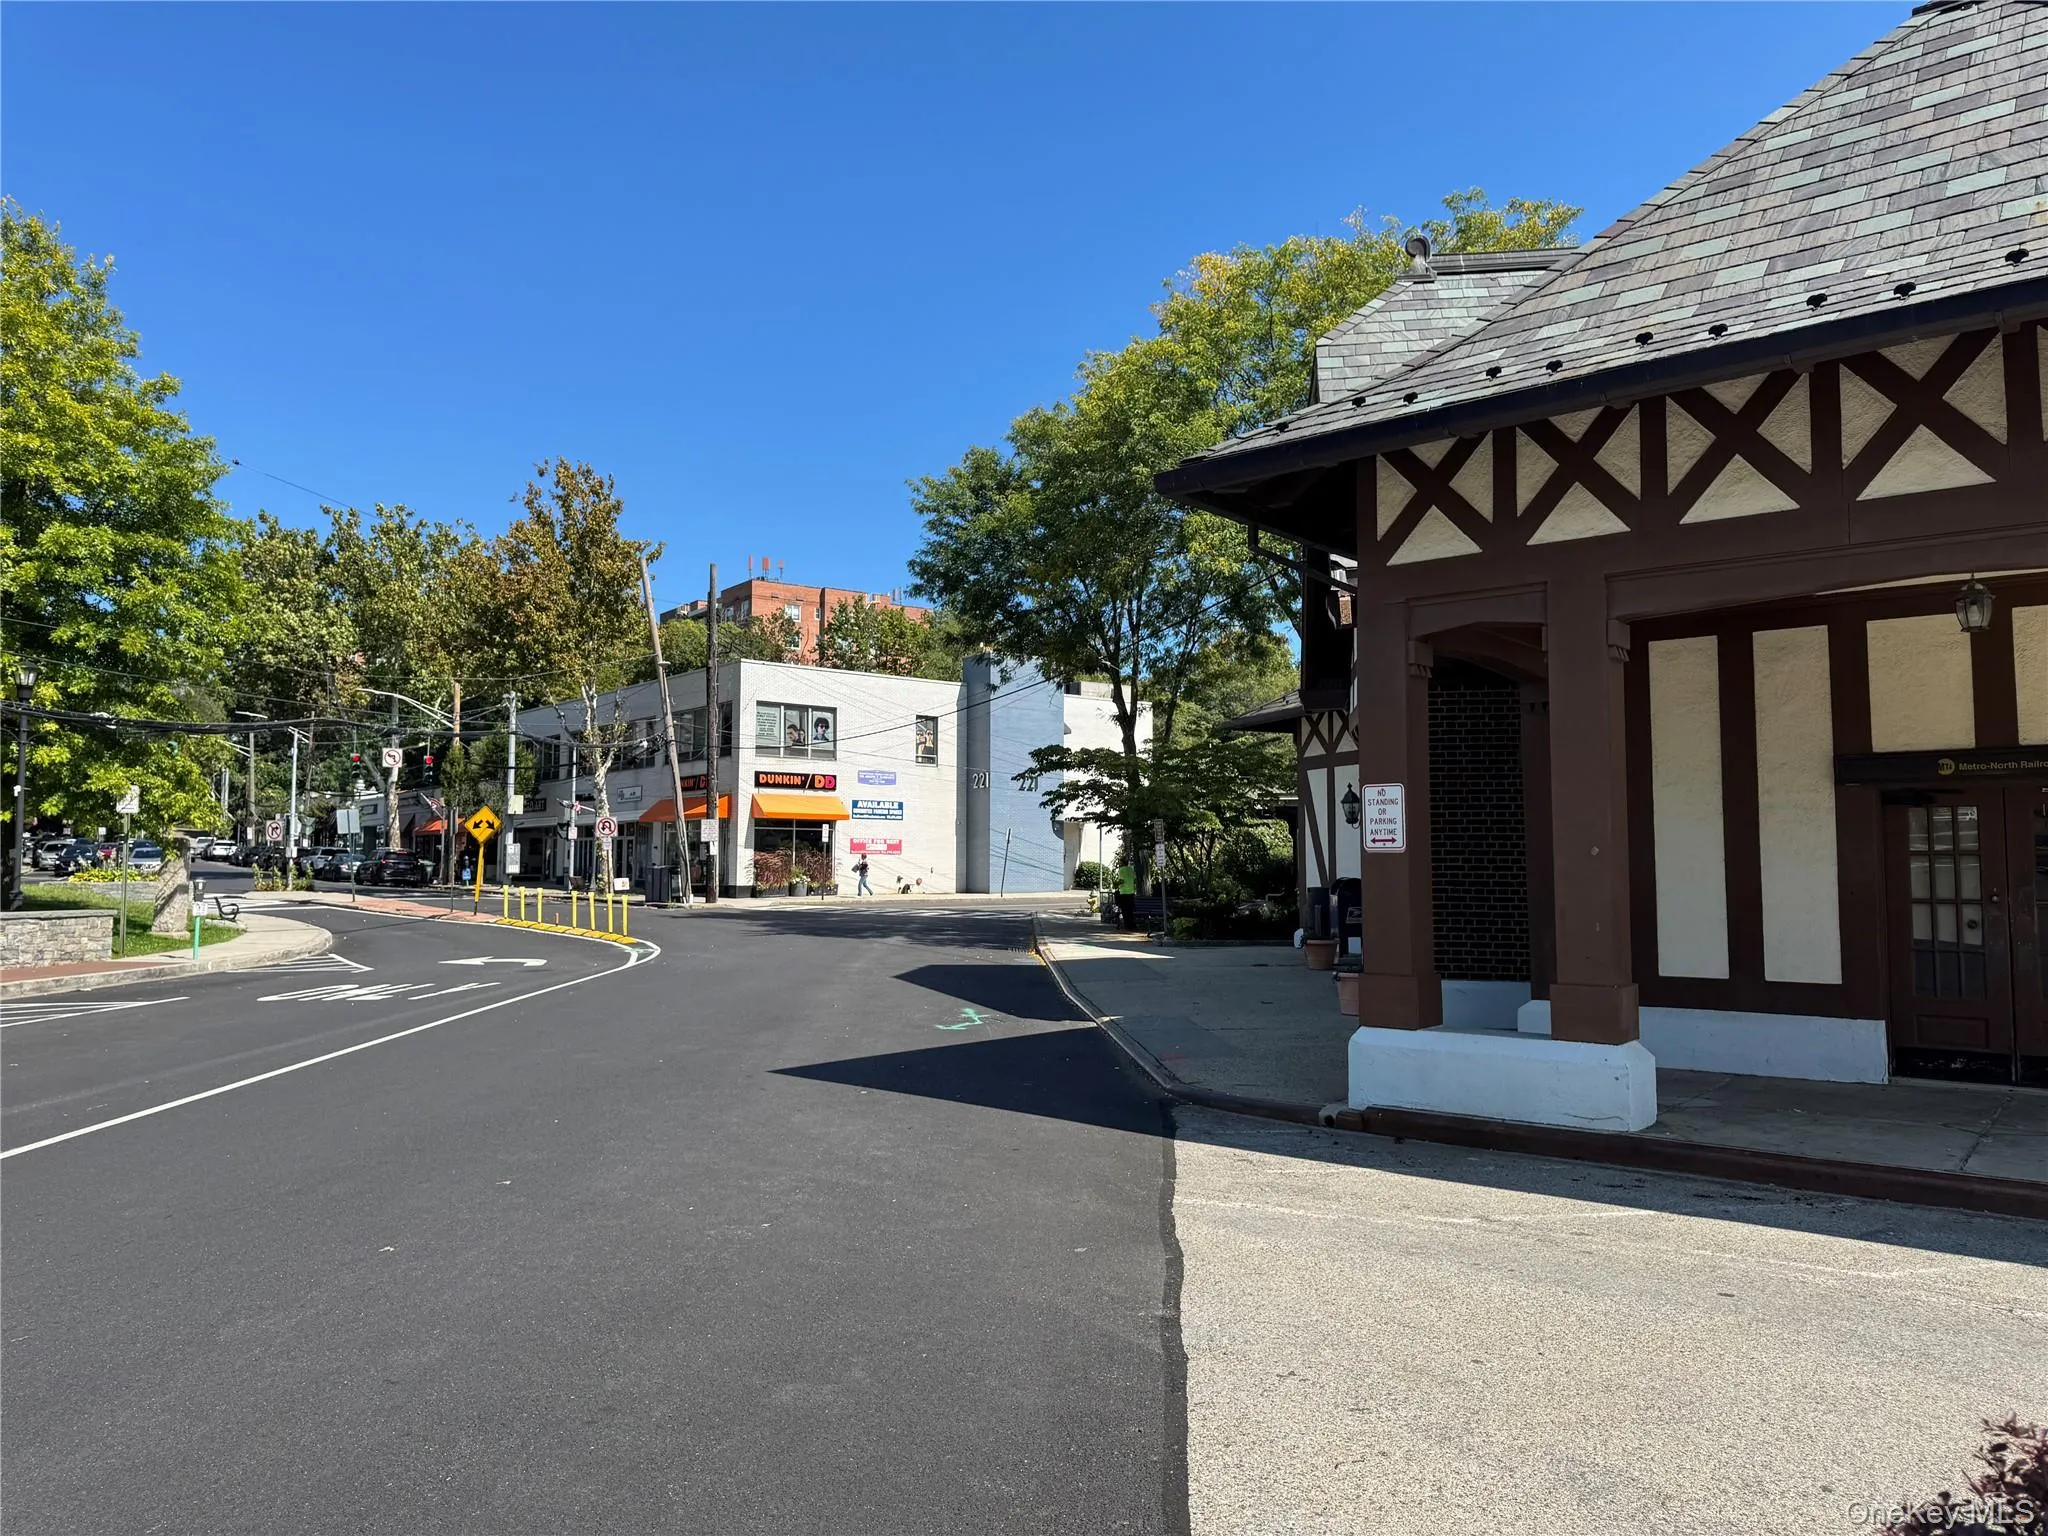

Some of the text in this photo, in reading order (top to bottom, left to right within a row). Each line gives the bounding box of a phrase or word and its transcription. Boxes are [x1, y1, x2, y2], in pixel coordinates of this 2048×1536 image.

[1958, 761, 2018, 771] Metro-North
[759, 773, 836, 789] DUNKIN' DD
[972, 772, 989, 789] 221
[857, 801, 899, 809] AVAILABLE
[1378, 808, 1387, 816] OR
